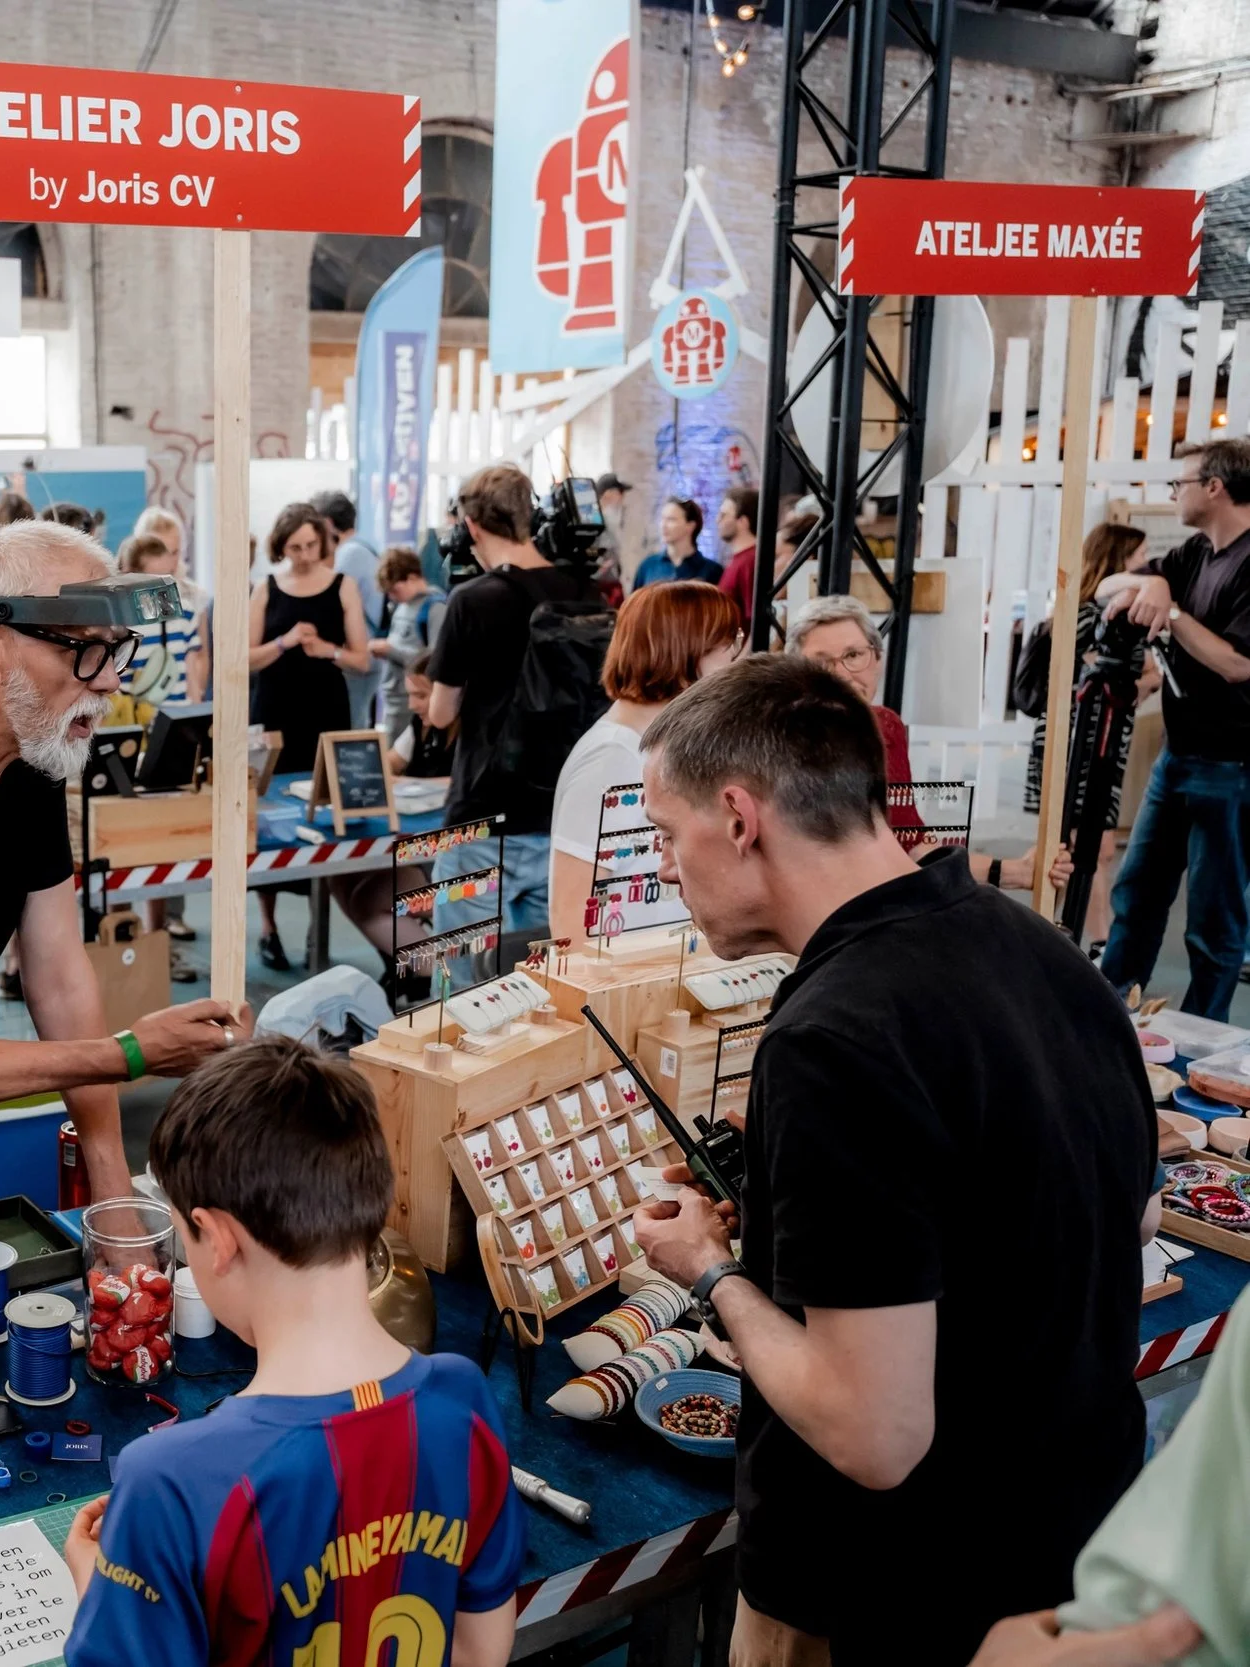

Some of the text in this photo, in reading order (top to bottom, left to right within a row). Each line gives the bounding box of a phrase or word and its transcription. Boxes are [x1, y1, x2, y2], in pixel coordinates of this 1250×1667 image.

[158, 103, 301, 155] JORIS
[29, 168, 215, 209] by Joris CV
[915, 217, 1143, 259] ATELJEE MAXÉE
[28, 1567, 53, 1581] om
[14, 1586, 39, 1600] in
[39, 1595, 64, 1610] te
